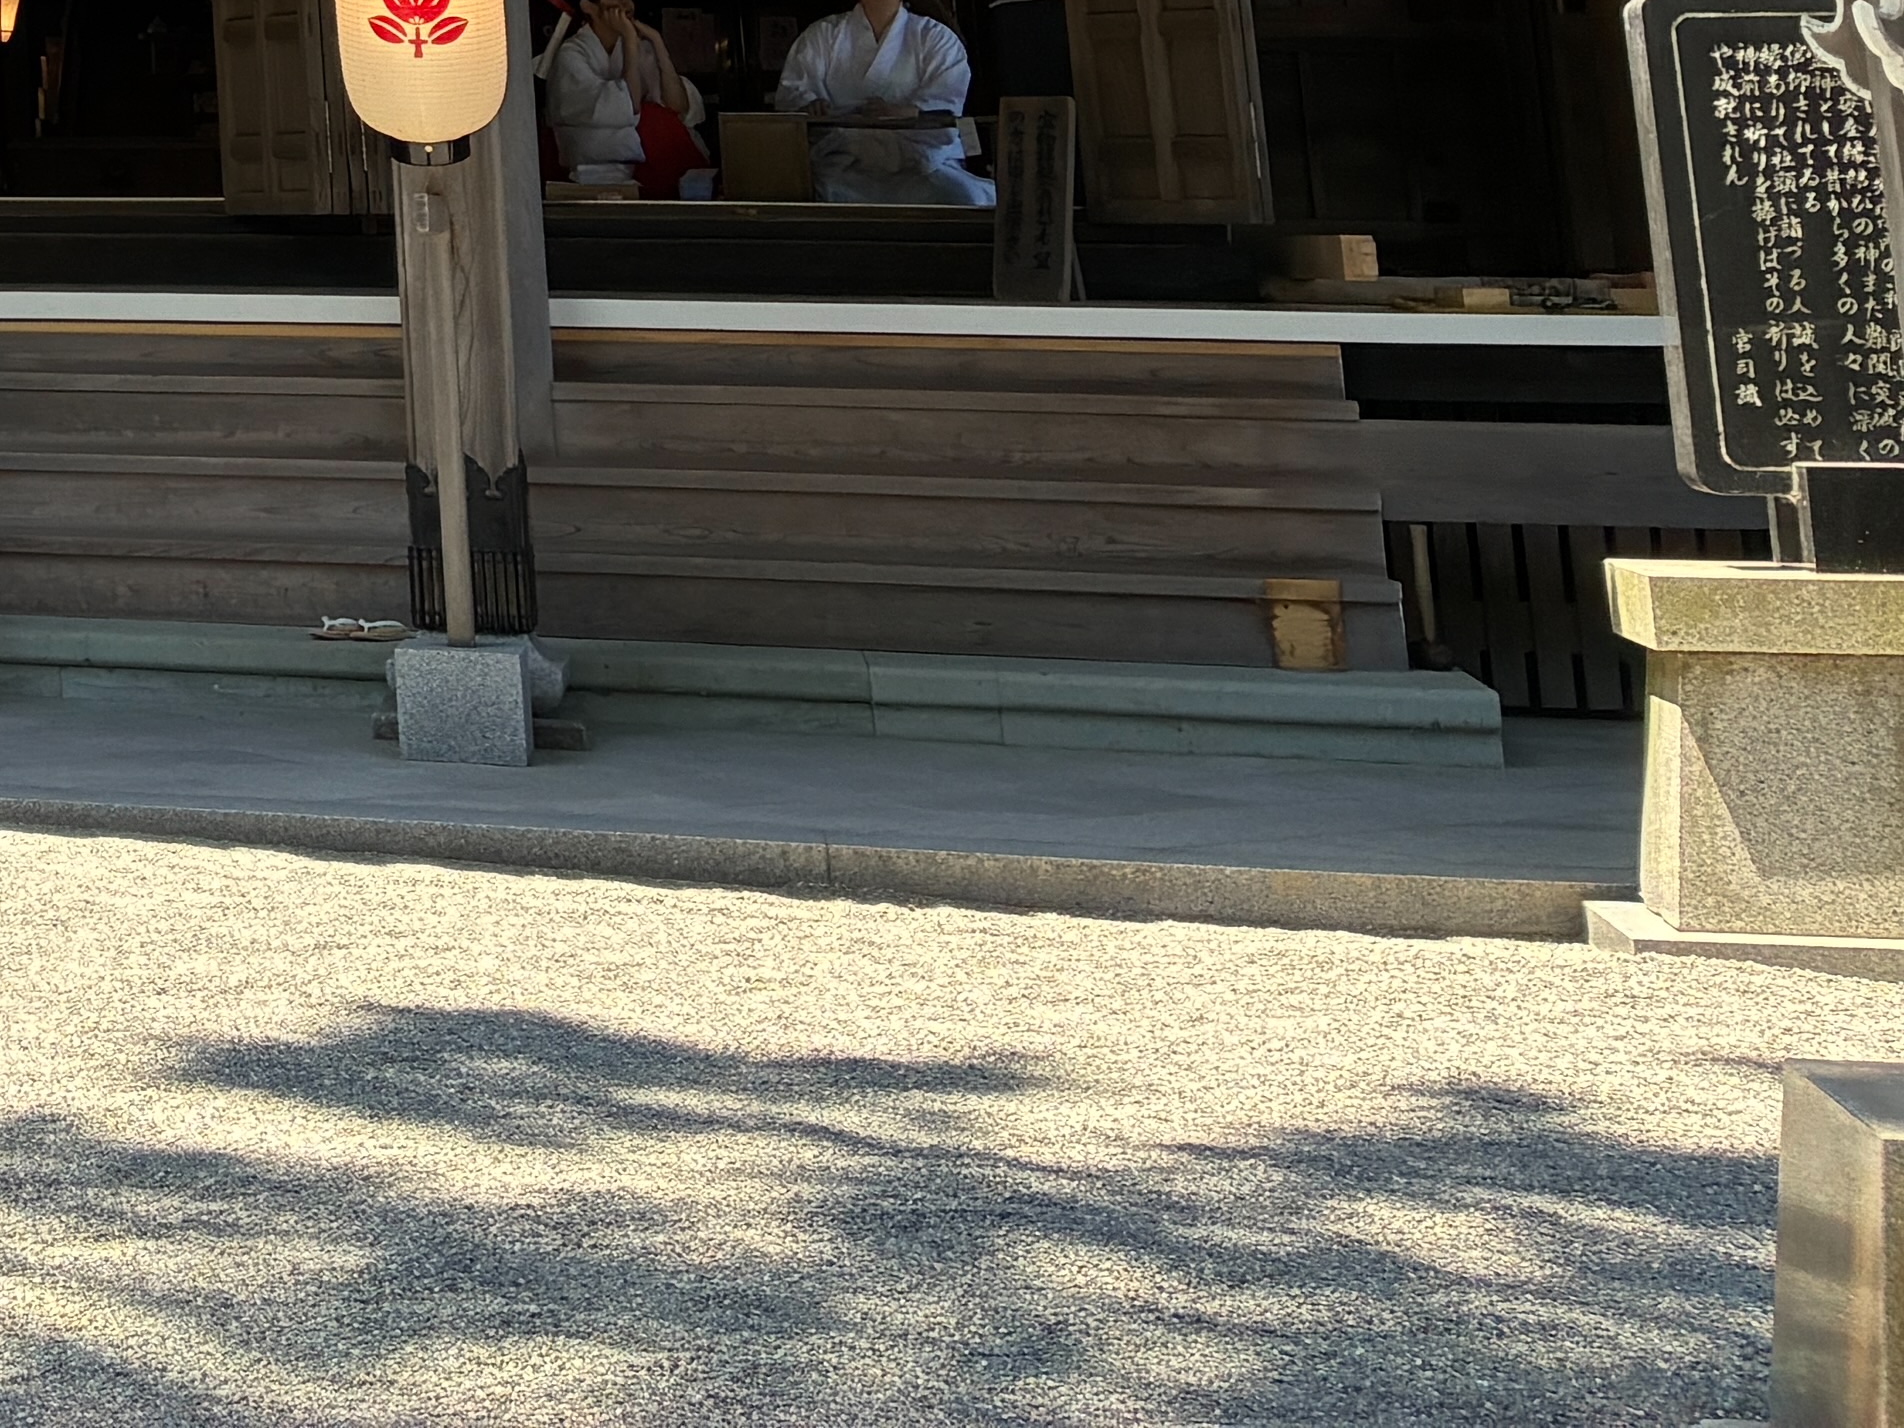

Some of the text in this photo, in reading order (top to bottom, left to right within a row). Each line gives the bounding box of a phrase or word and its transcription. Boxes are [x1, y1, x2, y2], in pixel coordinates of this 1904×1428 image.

[1710, 43, 1748, 186] や成就されん
[1784, 42, 1821, 212] 信仰されてゐる
